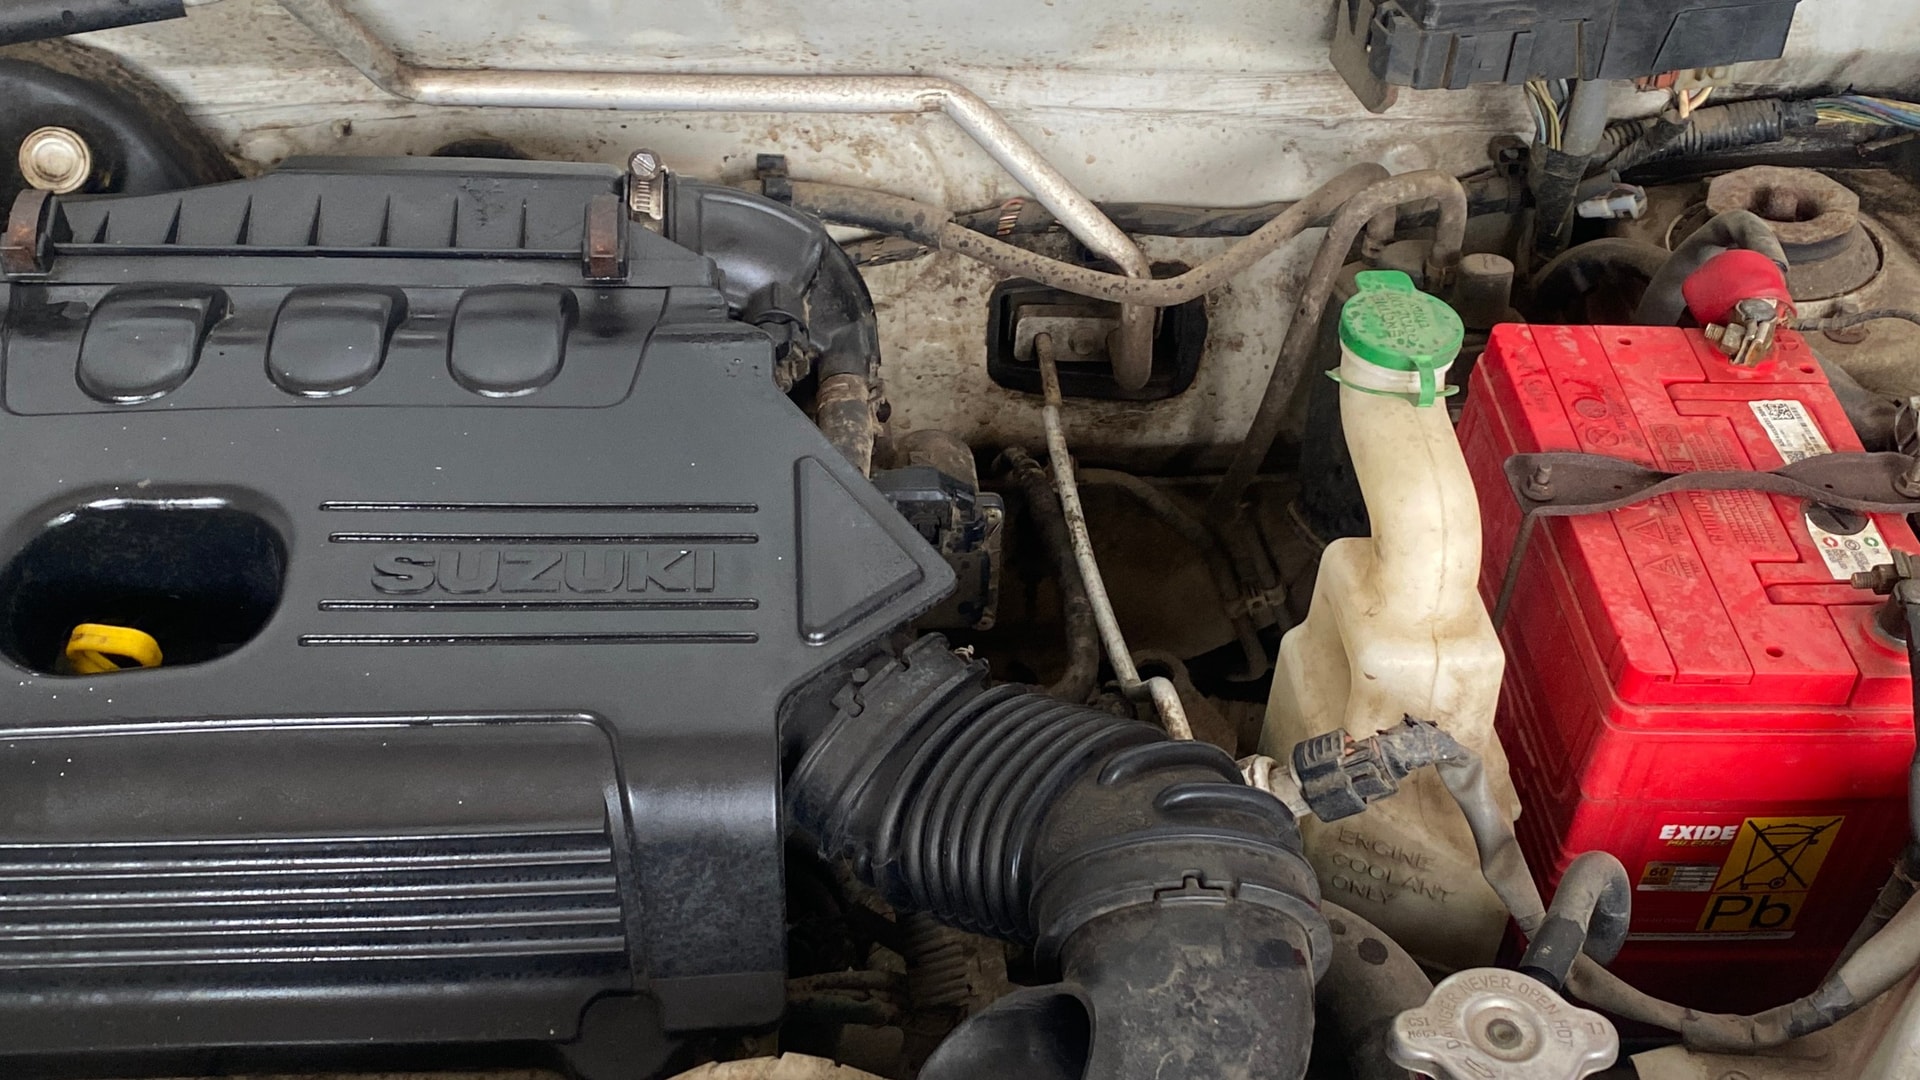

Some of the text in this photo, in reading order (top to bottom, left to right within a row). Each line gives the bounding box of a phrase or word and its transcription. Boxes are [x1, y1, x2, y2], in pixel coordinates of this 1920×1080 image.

[371, 549, 715, 594] SUZUKI
[1338, 827, 1436, 871] ENGINE
[1658, 824, 1739, 840] EXIDE
[1332, 874, 1399, 905] ONLY
[1333, 852, 1456, 903] COOLANT
[1703, 895, 1792, 931] Pb
[1437, 974, 1575, 1050] DANGER NEVER OPEN HOT
